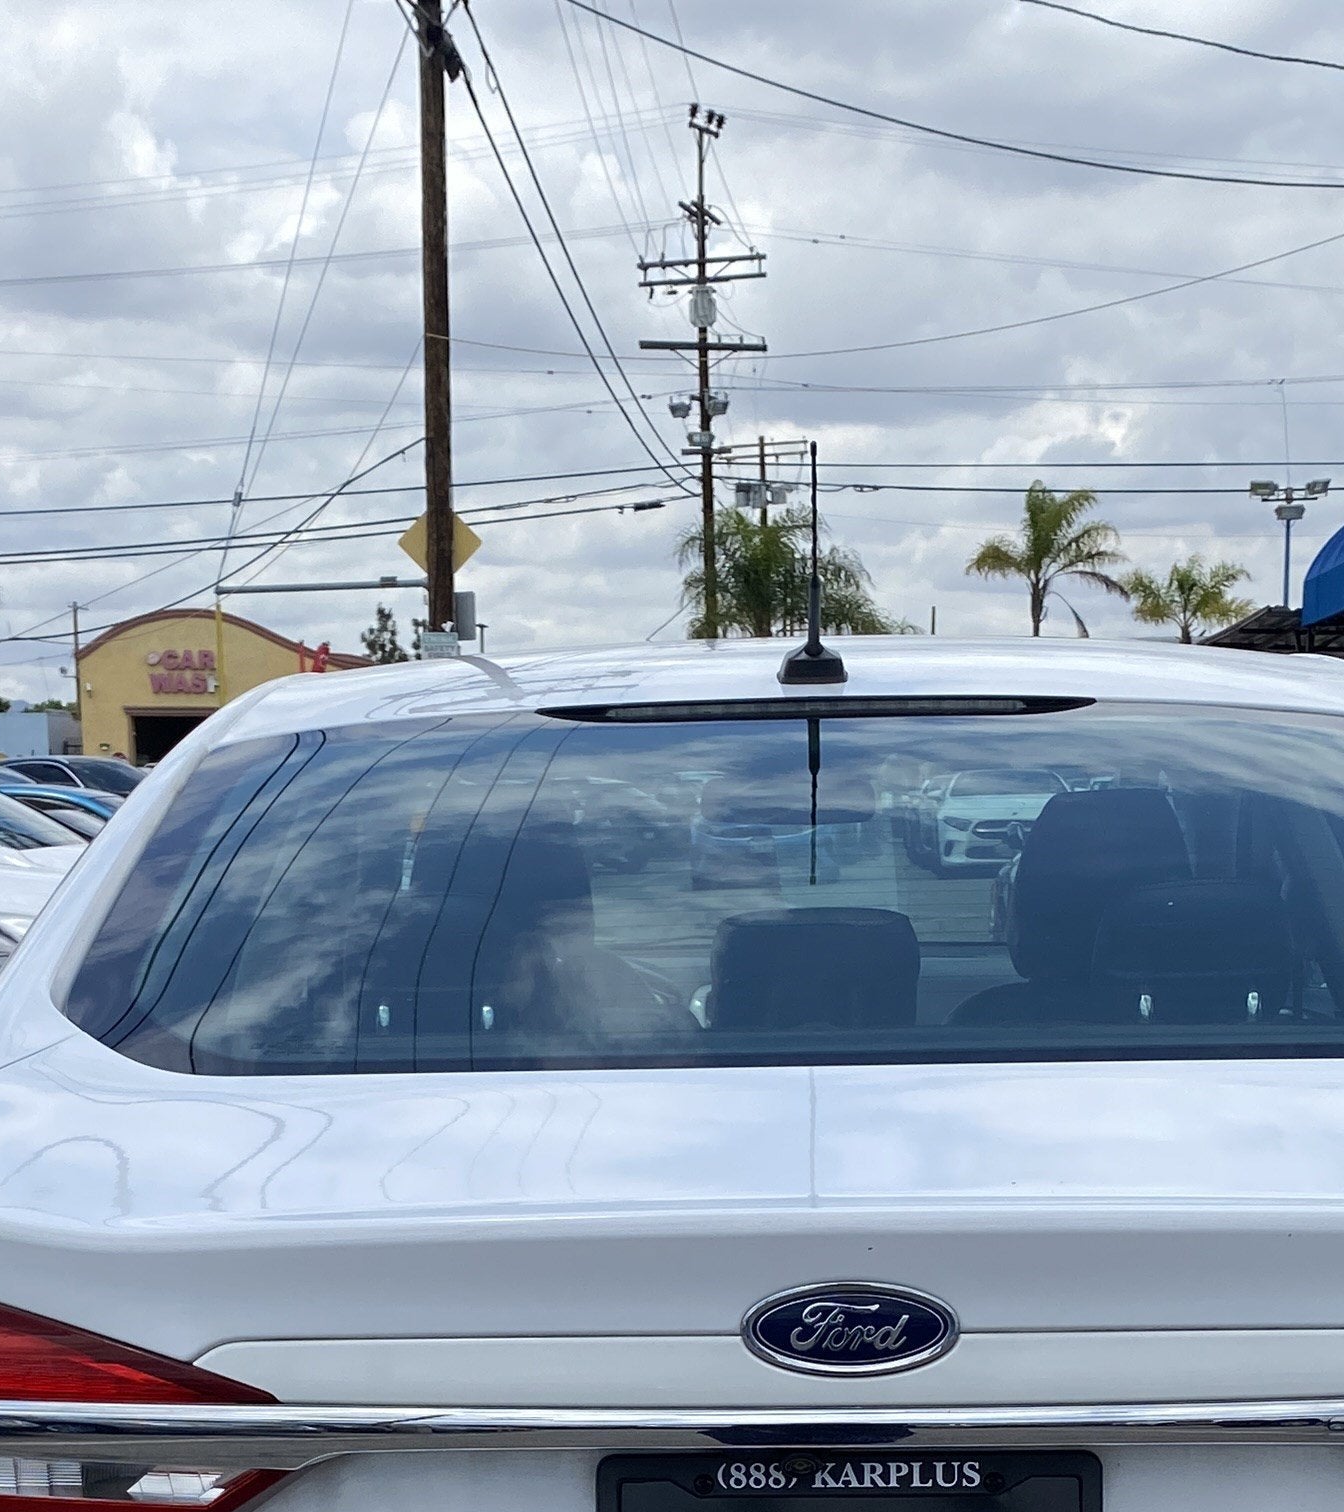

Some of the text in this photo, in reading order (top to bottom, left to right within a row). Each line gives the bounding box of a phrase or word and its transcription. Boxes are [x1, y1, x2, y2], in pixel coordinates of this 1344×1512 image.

[161, 649, 215, 670] CAR
[790, 1302, 909, 1352] Ford
[811, 1461, 981, 1488] KARPLUS
